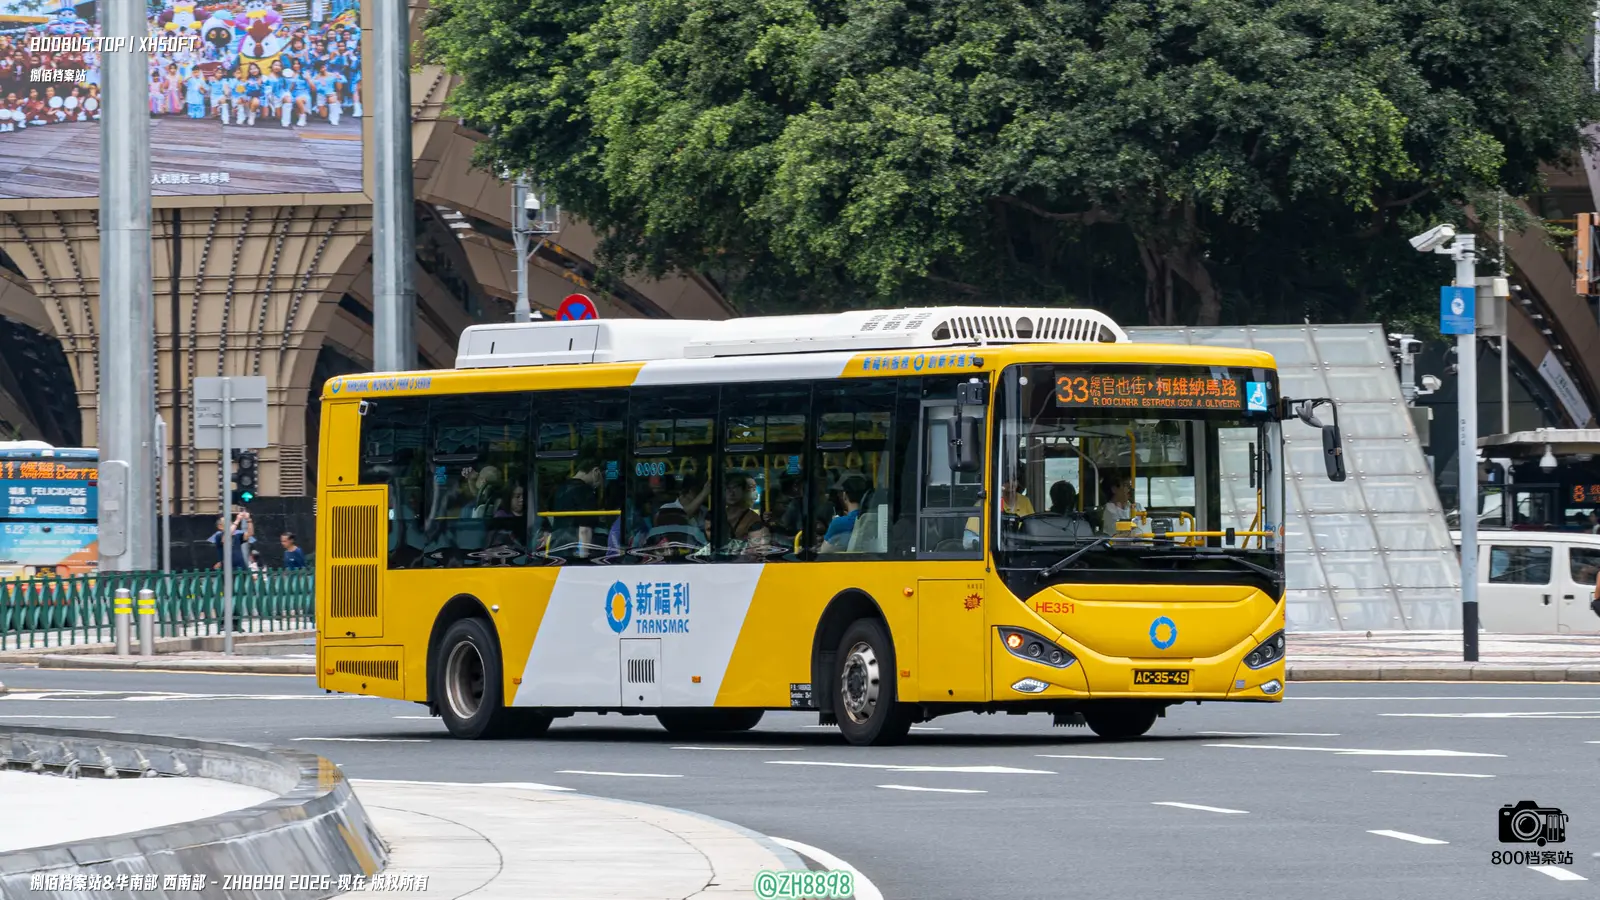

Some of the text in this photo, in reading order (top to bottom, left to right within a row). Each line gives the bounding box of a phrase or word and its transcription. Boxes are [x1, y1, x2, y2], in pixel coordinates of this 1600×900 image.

[1057, 376, 1089, 403] 33
[1102, 376, 1237, 397] 官也街 柯維納馬路
[1113, 398, 1139, 407] CUNHA
[1142, 398, 1175, 408] ESTRADA
[1205, 399, 1241, 409] OLIVEIRA
[56, 464, 98, 479] Barra
[31, 487, 87, 496] FELICIDADE
[9, 496, 37, 505] TIPSY
[636, 581, 690, 615] 新福利
[1036, 601, 1075, 614] HE351
[636, 619, 689, 634] TRANSMAC
[1135, 671, 1188, 683] AC-35-49
